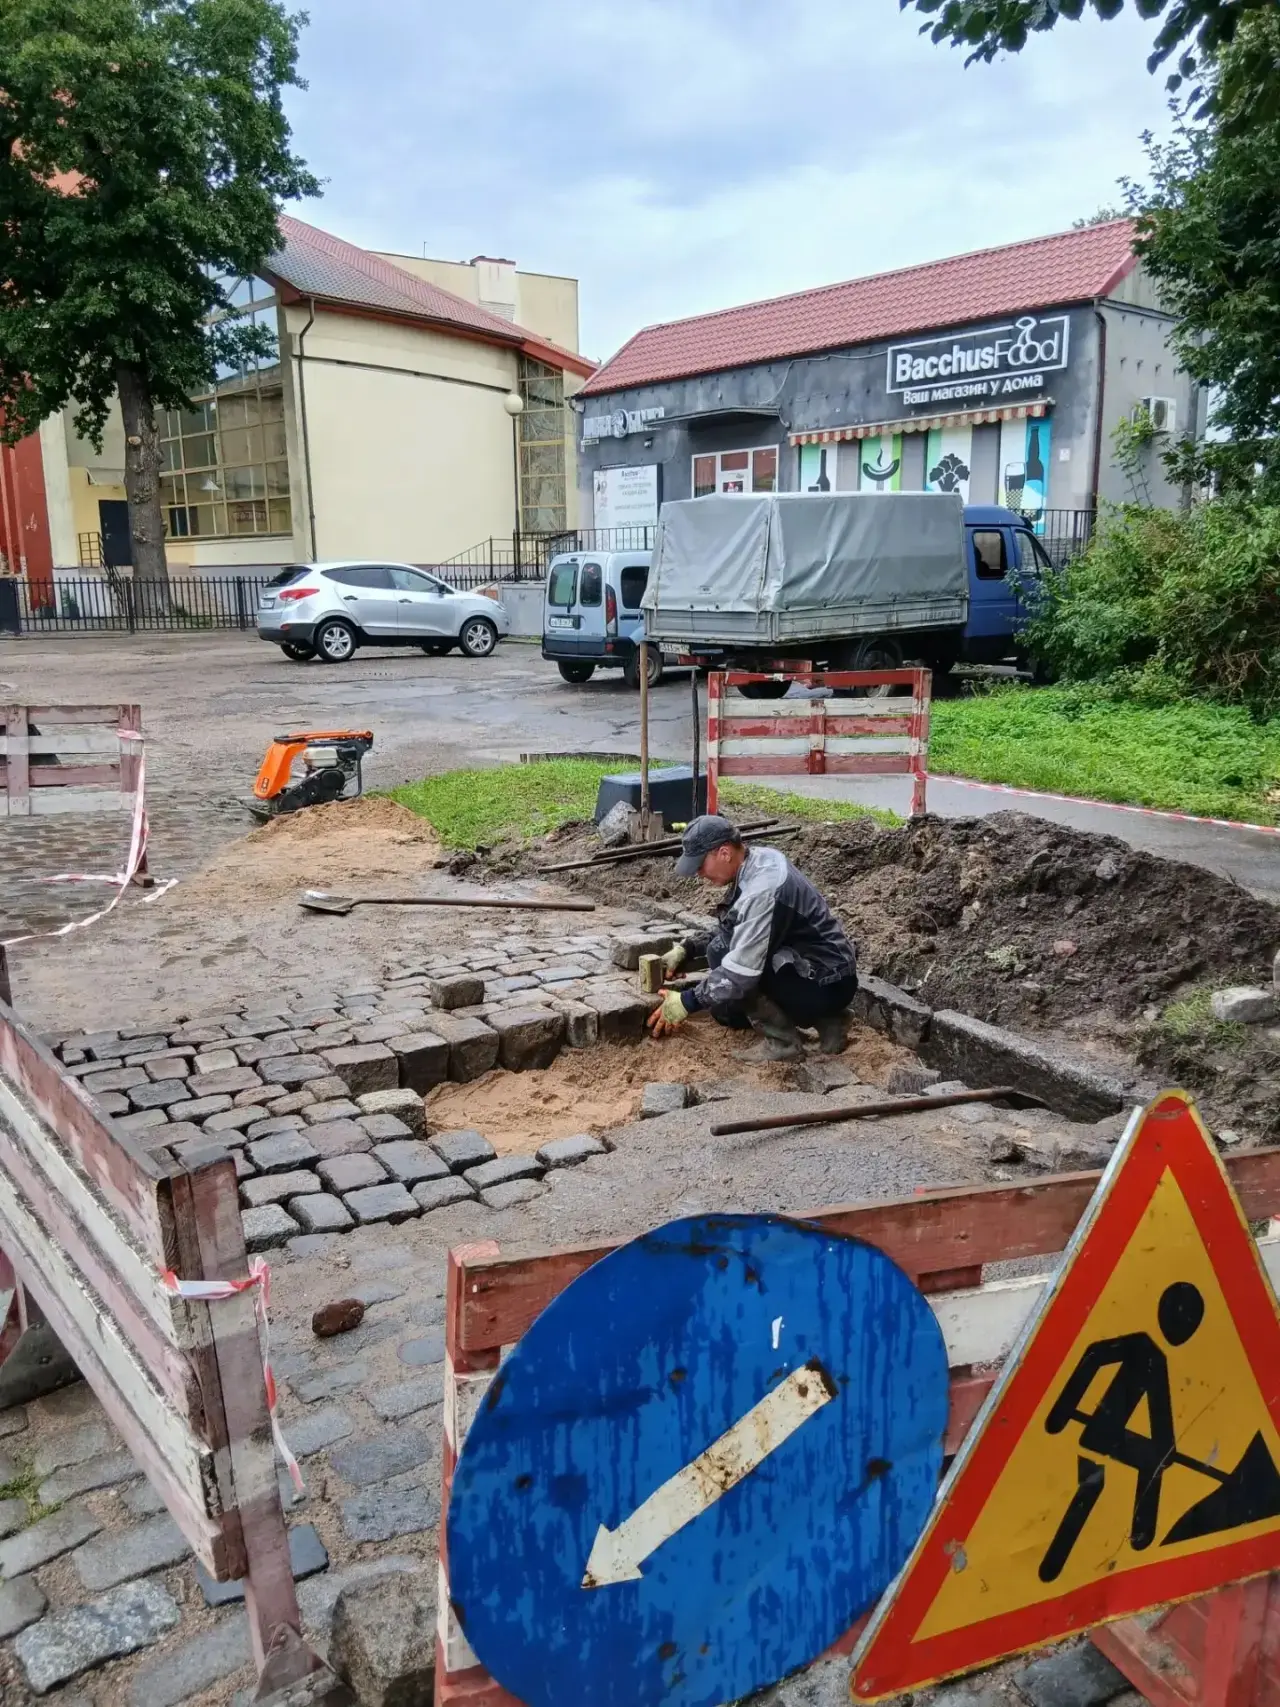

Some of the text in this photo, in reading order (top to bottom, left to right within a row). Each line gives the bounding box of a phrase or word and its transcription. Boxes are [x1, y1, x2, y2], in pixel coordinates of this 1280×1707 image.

[896, 331, 1059, 383] BacchusFood
[903, 389, 930, 405] Ваш
[931, 383, 988, 401] магазин
[1002, 374, 1044, 394] дома
